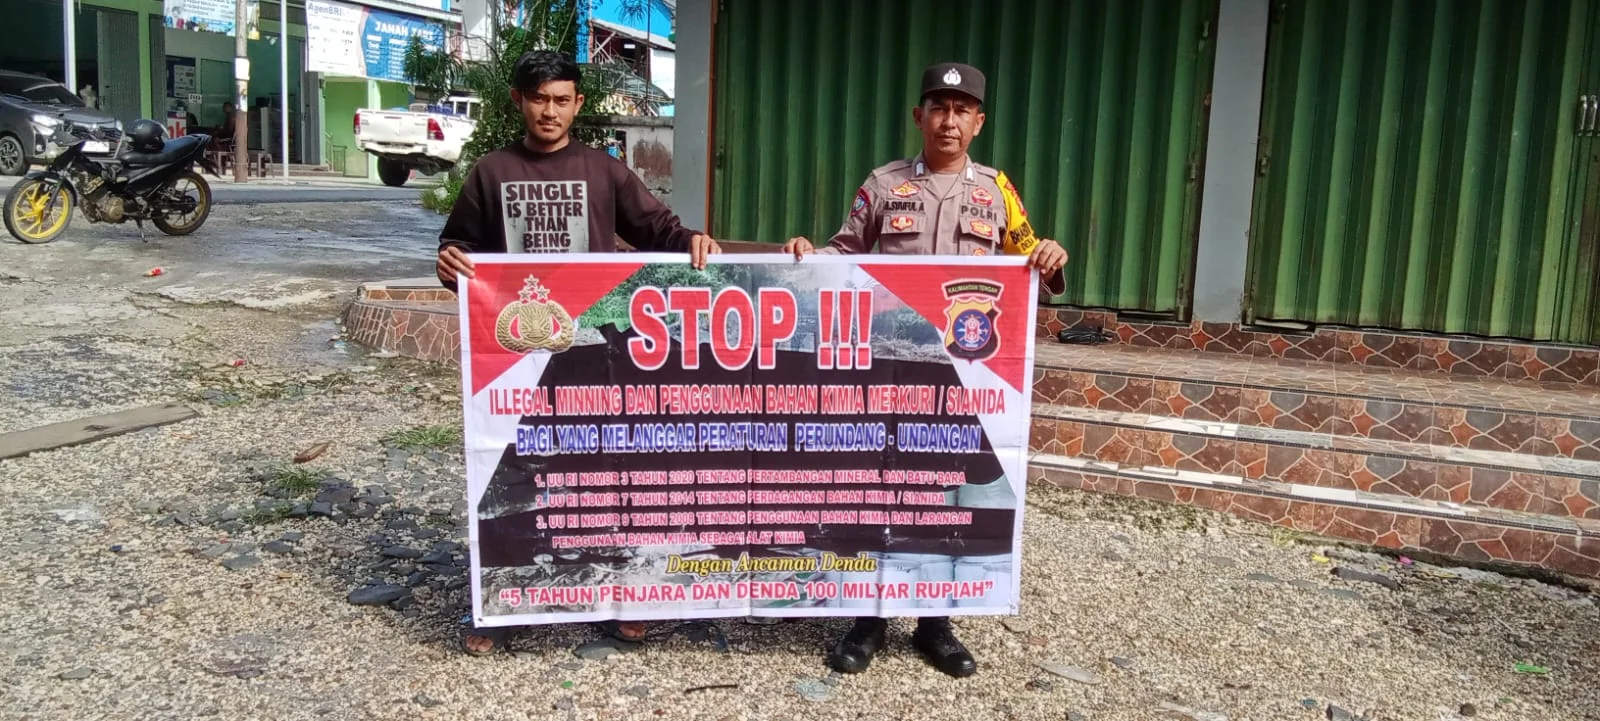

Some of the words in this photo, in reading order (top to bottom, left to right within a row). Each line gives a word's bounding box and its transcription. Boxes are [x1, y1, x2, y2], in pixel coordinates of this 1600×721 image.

[506, 183, 584, 201] SINGLE
[506, 203, 522, 218] IS
[526, 202, 584, 217] BETTER
[961, 205, 998, 222] POLRI
[524, 217, 568, 232] THAN
[523, 232, 571, 248] BEING
[628, 286, 798, 371] STOP
[490, 386, 552, 416] ILLEGAL
[556, 385, 622, 416] MINNING
[625, 384, 656, 415] DAN
[660, 384, 762, 415] PENGGUNAAN
[766, 384, 817, 414] BAHAN
[821, 384, 865, 414] KIMIA
[868, 384, 935, 415] MERKURI
[946, 386, 1006, 416] SIANIDA
[516, 424, 553, 455] BAGI
[555, 424, 600, 454] YANG
[602, 422, 697, 454] MELANGGAR
[700, 422, 787, 452] PERATURAN
[795, 422, 886, 452] PERUNDANG
[897, 422, 982, 454] UNDANGAN
[534, 474, 546, 488] 1.
[547, 473, 564, 486] UU
[566, 472, 578, 486] RI
[580, 472, 620, 486] NOMOR
[620, 472, 628, 486] 3
[629, 471, 668, 485] TAHUN
[669, 470, 695, 485] 2020
[696, 470, 746, 484] TENTANG
[748, 469, 833, 484] PERTAMBANGAN
[834, 470, 881, 484] MINERAL
[882, 470, 906, 484] DAN
[906, 470, 936, 484] BATU
[937, 472, 966, 486] BARA
[536, 496, 546, 508] 2.
[549, 494, 566, 508] UU
[567, 494, 578, 507] RI
[580, 492, 620, 507] NOMOR
[621, 493, 628, 506] 7
[630, 492, 668, 506] TAHUN
[669, 492, 695, 506] 2014
[696, 491, 746, 505] TENTANG
[748, 490, 826, 504] PERDAGANGAN
[826, 490, 864, 504] BAHAN
[865, 490, 896, 504] KIMIA
[902, 491, 945, 506] SIANIDA
[536, 516, 548, 530] 3.
[549, 514, 566, 529] UU
[567, 514, 579, 528] RI
[580, 514, 620, 528] NOMOR
[621, 514, 629, 527] 9
[630, 513, 668, 527] TAHUN
[669, 512, 696, 526] 2008
[696, 512, 746, 526] TENTANG
[748, 511, 820, 524] PENGGUNAAN
[820, 511, 858, 524] BAHAN
[859, 511, 890, 526] KIMIA
[890, 512, 913, 524] DAN
[914, 512, 973, 525] LARANGAN
[552, 535, 625, 548] PENGGUNAAN
[628, 533, 665, 546] BAHAN
[667, 532, 698, 546] KIMIA
[746, 531, 774, 544] ALAT
[774, 531, 806, 544] KIMIA
[666, 553, 732, 576] Dengan
[735, 552, 817, 572] Ancaman
[820, 552, 878, 573] Denda
[526, 586, 594, 605] TAHUN
[599, 584, 686, 604] PENJARA
[692, 582, 732, 601] DAN
[736, 582, 798, 600] DENDA
[804, 582, 838, 600] 100
[842, 582, 909, 600] MILYAR
